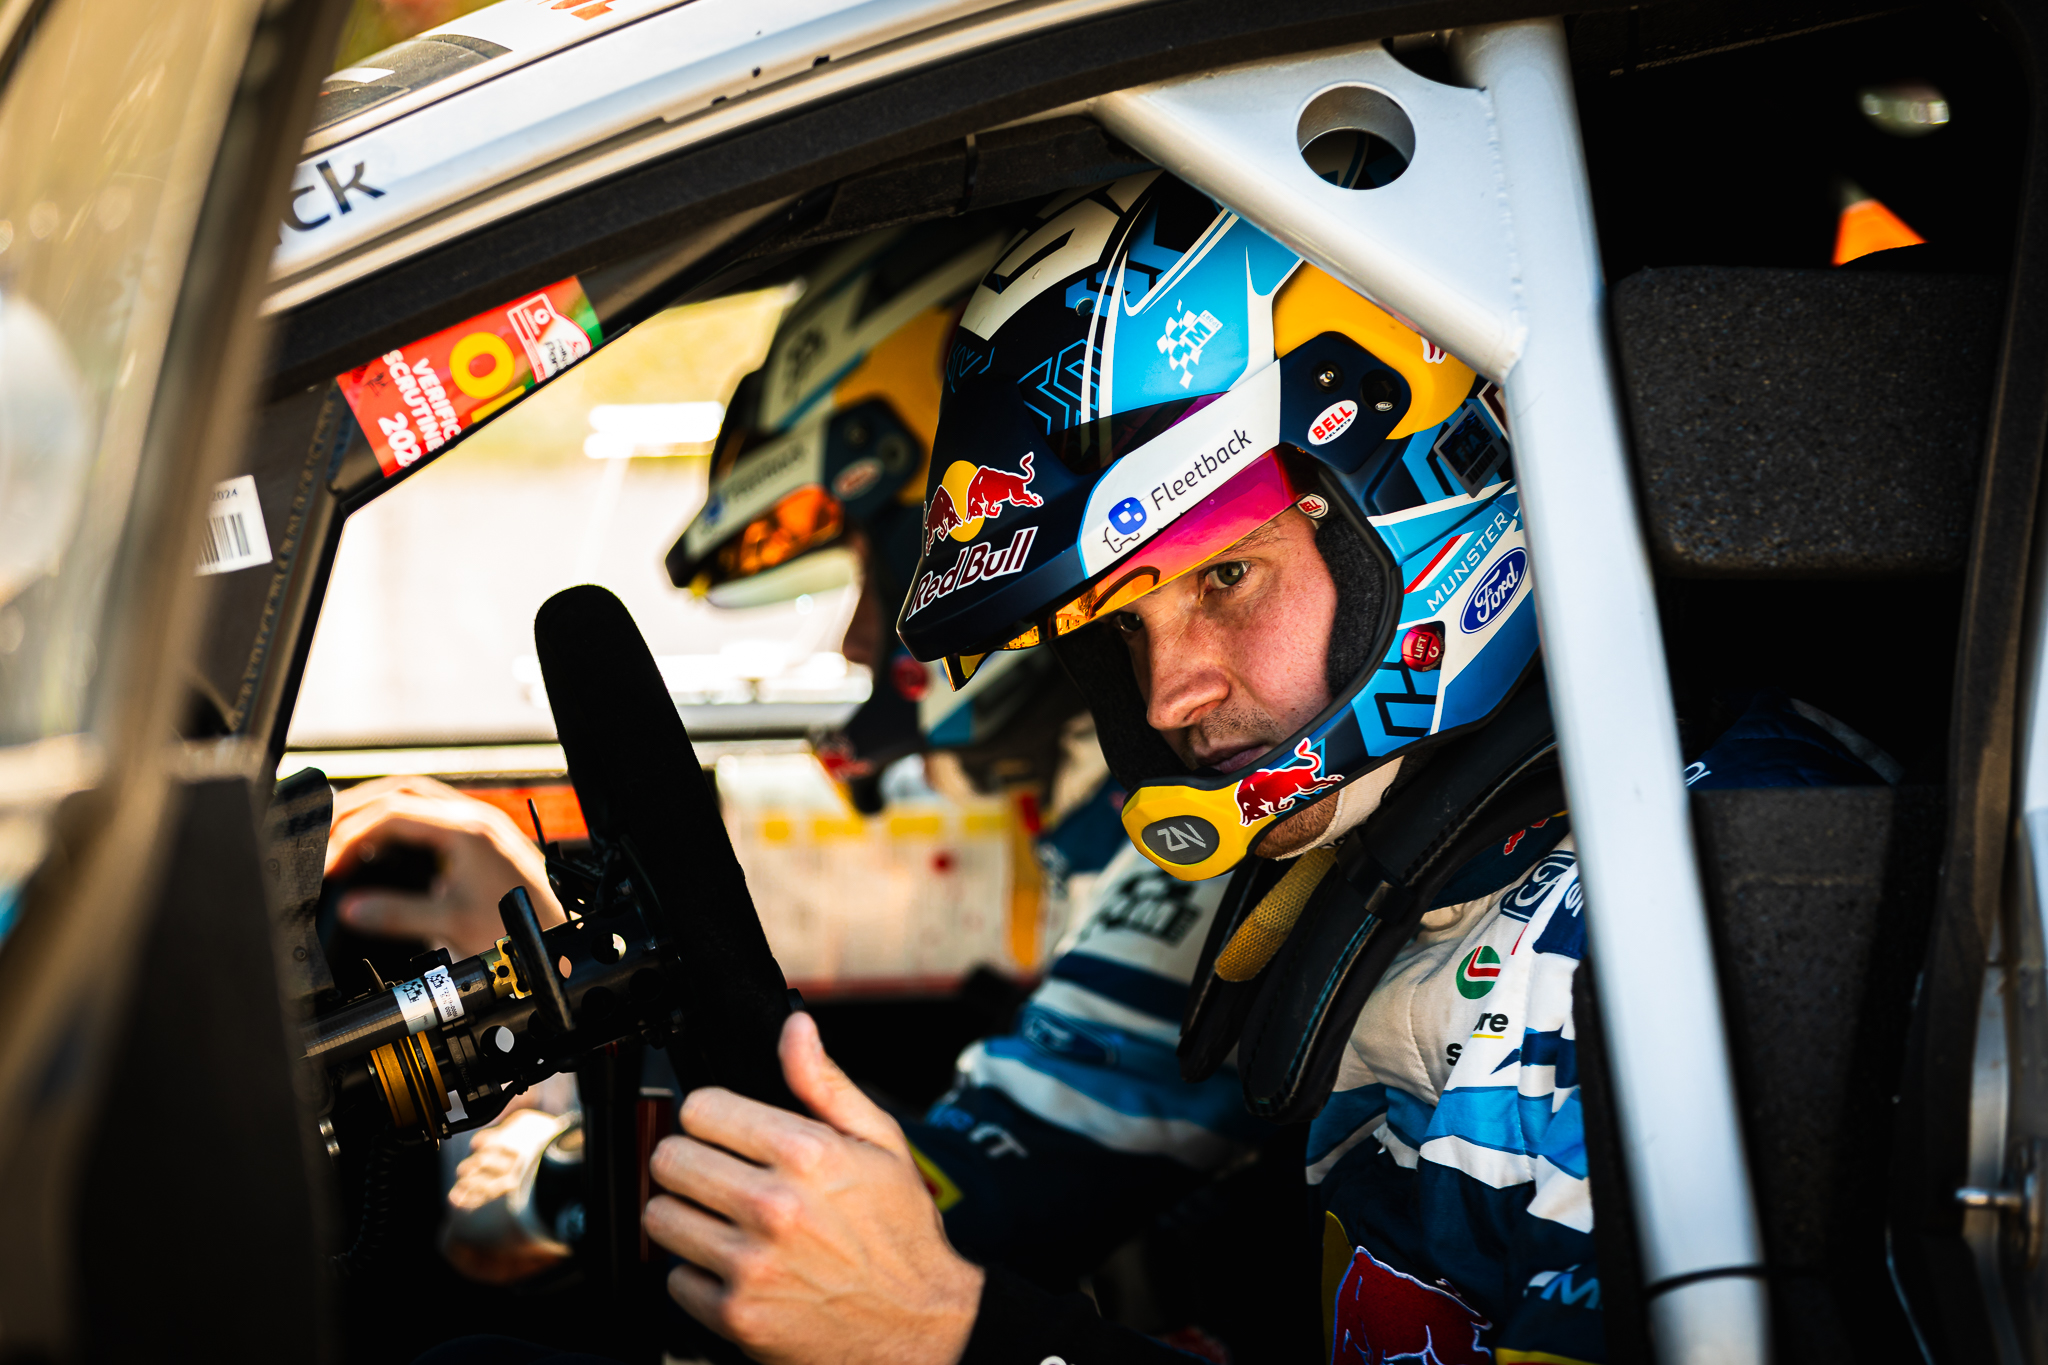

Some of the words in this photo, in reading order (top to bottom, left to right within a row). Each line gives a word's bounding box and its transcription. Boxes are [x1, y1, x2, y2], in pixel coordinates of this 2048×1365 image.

[279, 160, 386, 232] ck
[377, 411, 422, 468] 202
[1312, 406, 1353, 441] BELL
[1324, 418, 1351, 441] HELMETS
[212, 488, 239, 502] 2024
[1150, 429, 1253, 511] Fleetback
[905, 546, 970, 622] Red
[956, 526, 1039, 591] Bull
[1426, 511, 1509, 612] MUNSTER
[1474, 560, 1519, 623] Ford
[1413, 635, 1427, 659] LIFT
[1473, 1012, 1509, 1033] re
